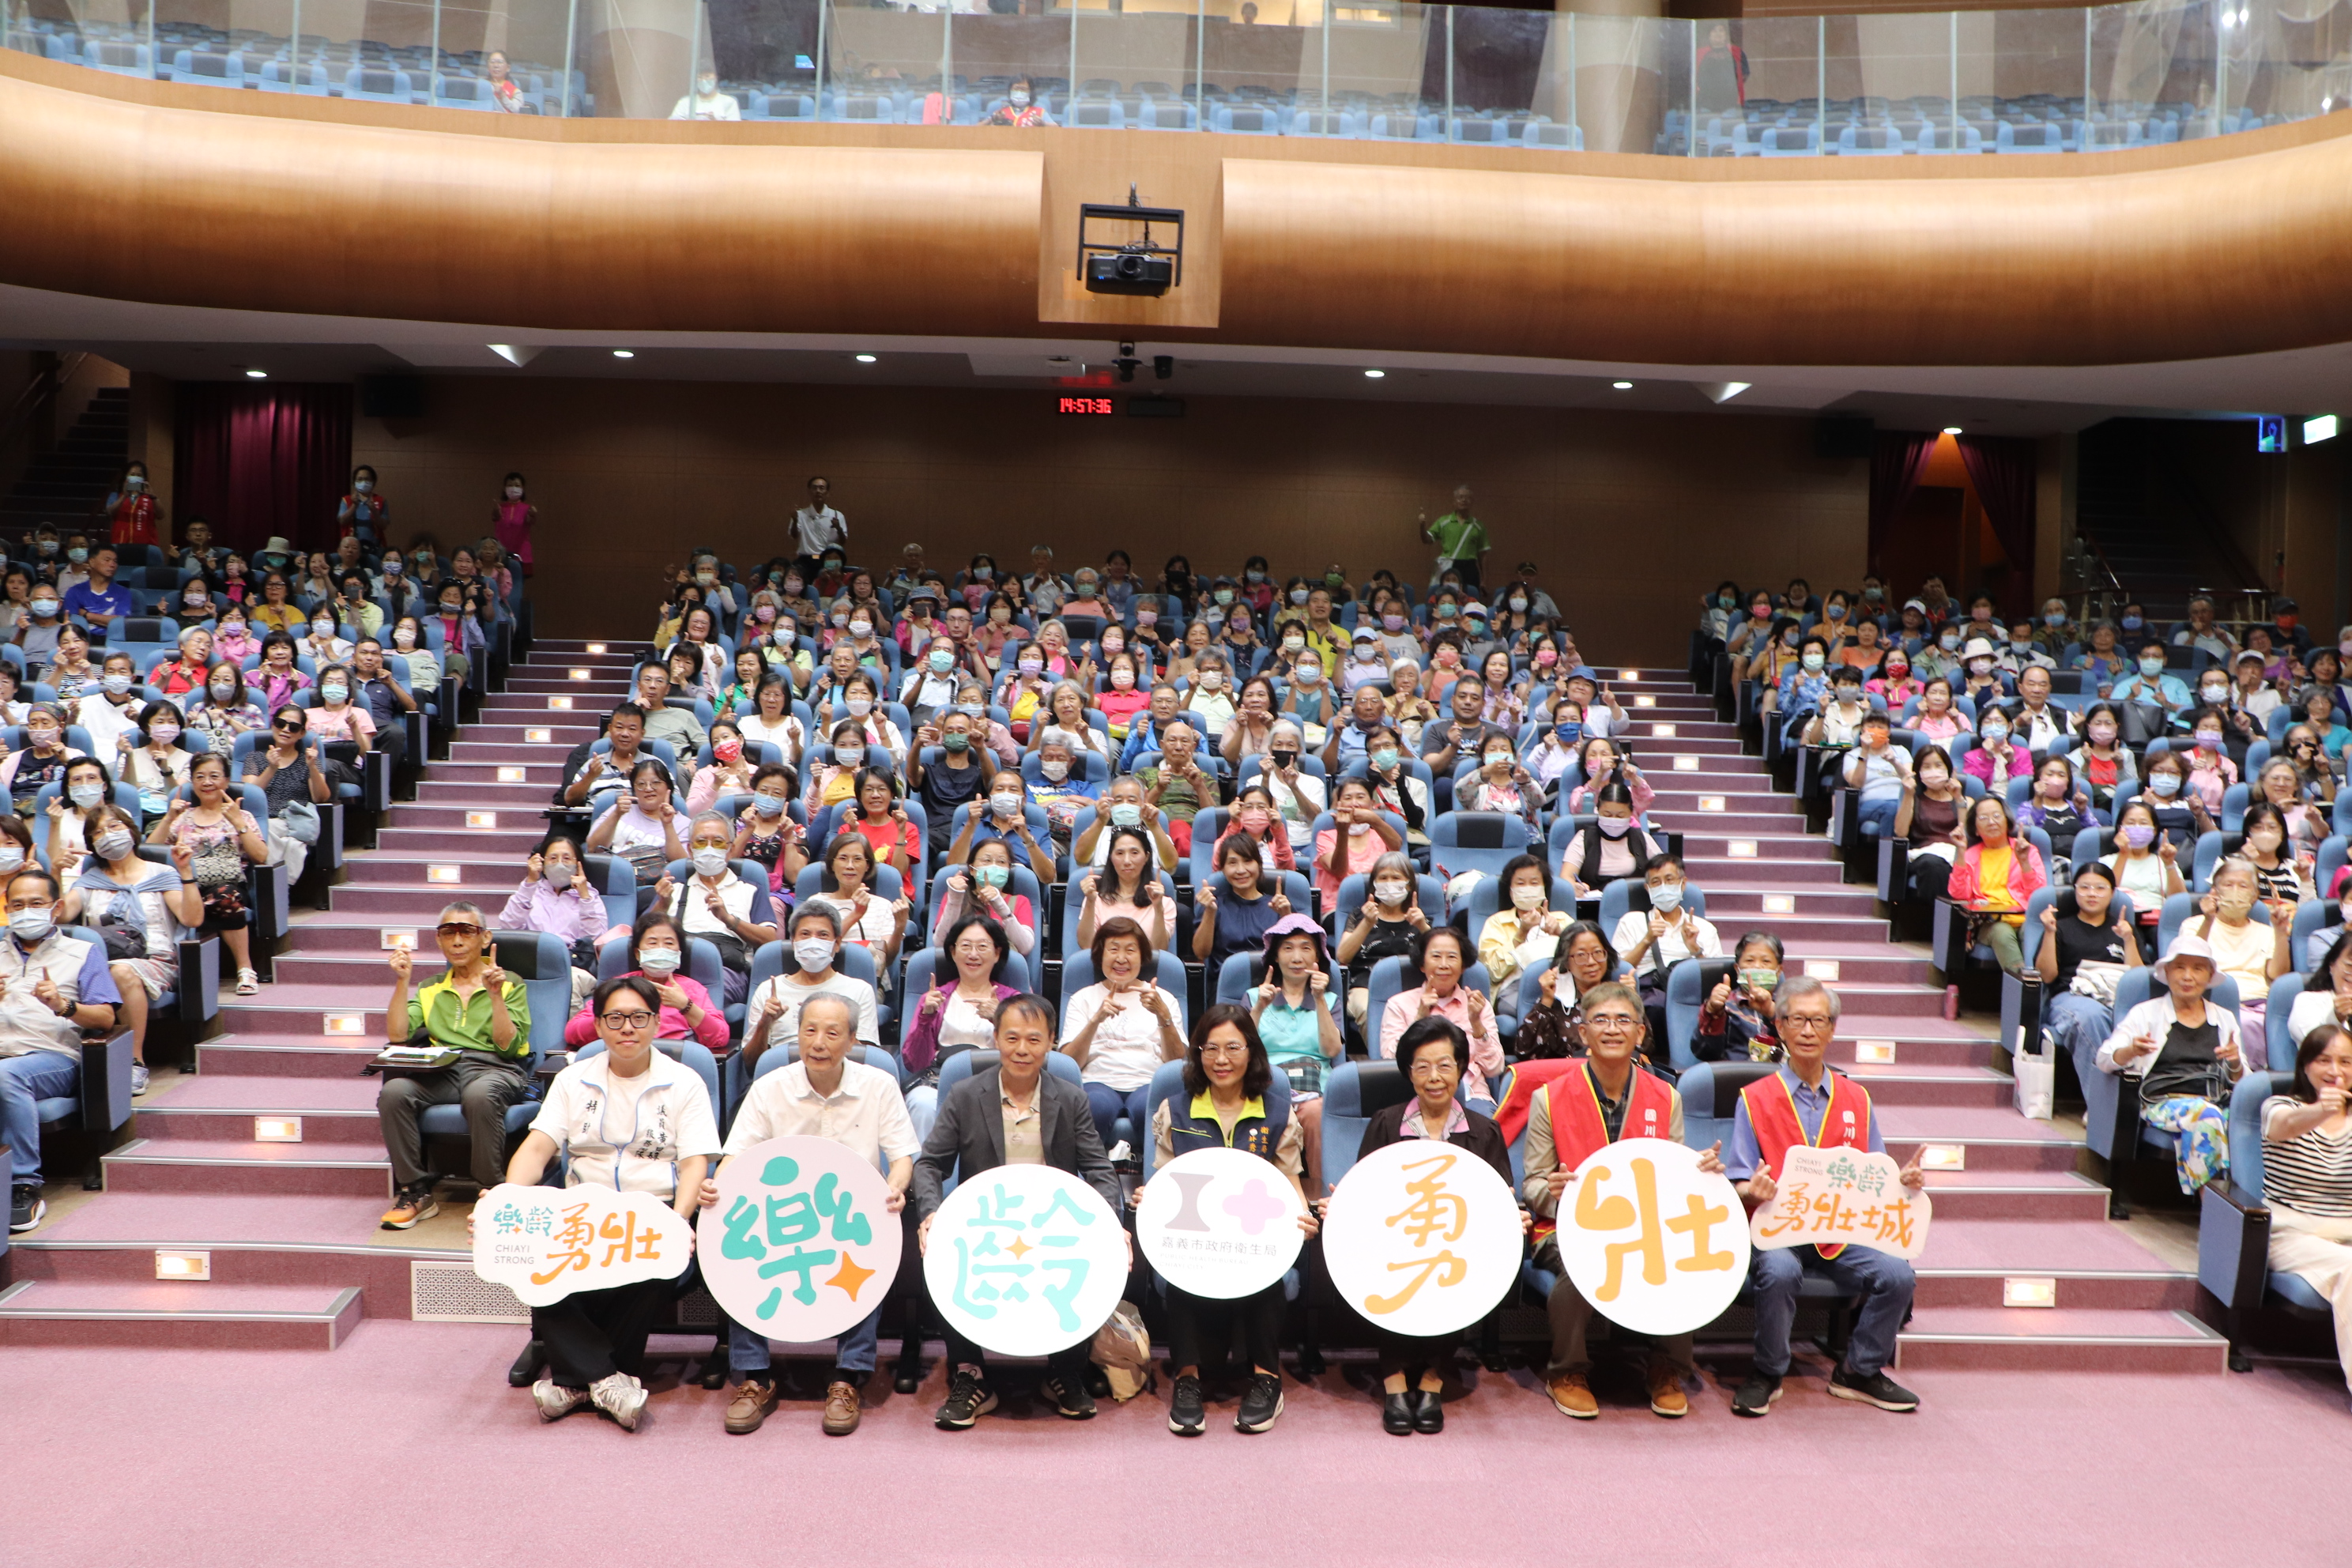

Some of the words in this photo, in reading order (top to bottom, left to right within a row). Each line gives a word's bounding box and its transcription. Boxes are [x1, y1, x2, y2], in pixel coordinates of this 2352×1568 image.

[1060, 398, 1111, 413] 14:57:36
[1795, 1165, 1823, 1176] STRONG
[1796, 1157, 1821, 1167] CHIAYI
[1826, 1156, 1889, 1197] 樂齡
[493, 1203, 554, 1237] 樂齡
[1575, 1158, 1736, 1302] 壯
[1760, 1182, 1914, 1249] 勇壯城
[496, 1244, 530, 1253] CHIAYI
[530, 1202, 662, 1286] 勇壯
[721, 1156, 876, 1321] 樂
[1161, 1236, 1277, 1257] 嘉義市政府衛生局
[1364, 1154, 1468, 1315] 勇
[494, 1256, 535, 1265] STRONG
[952, 1183, 1096, 1332] 齡
